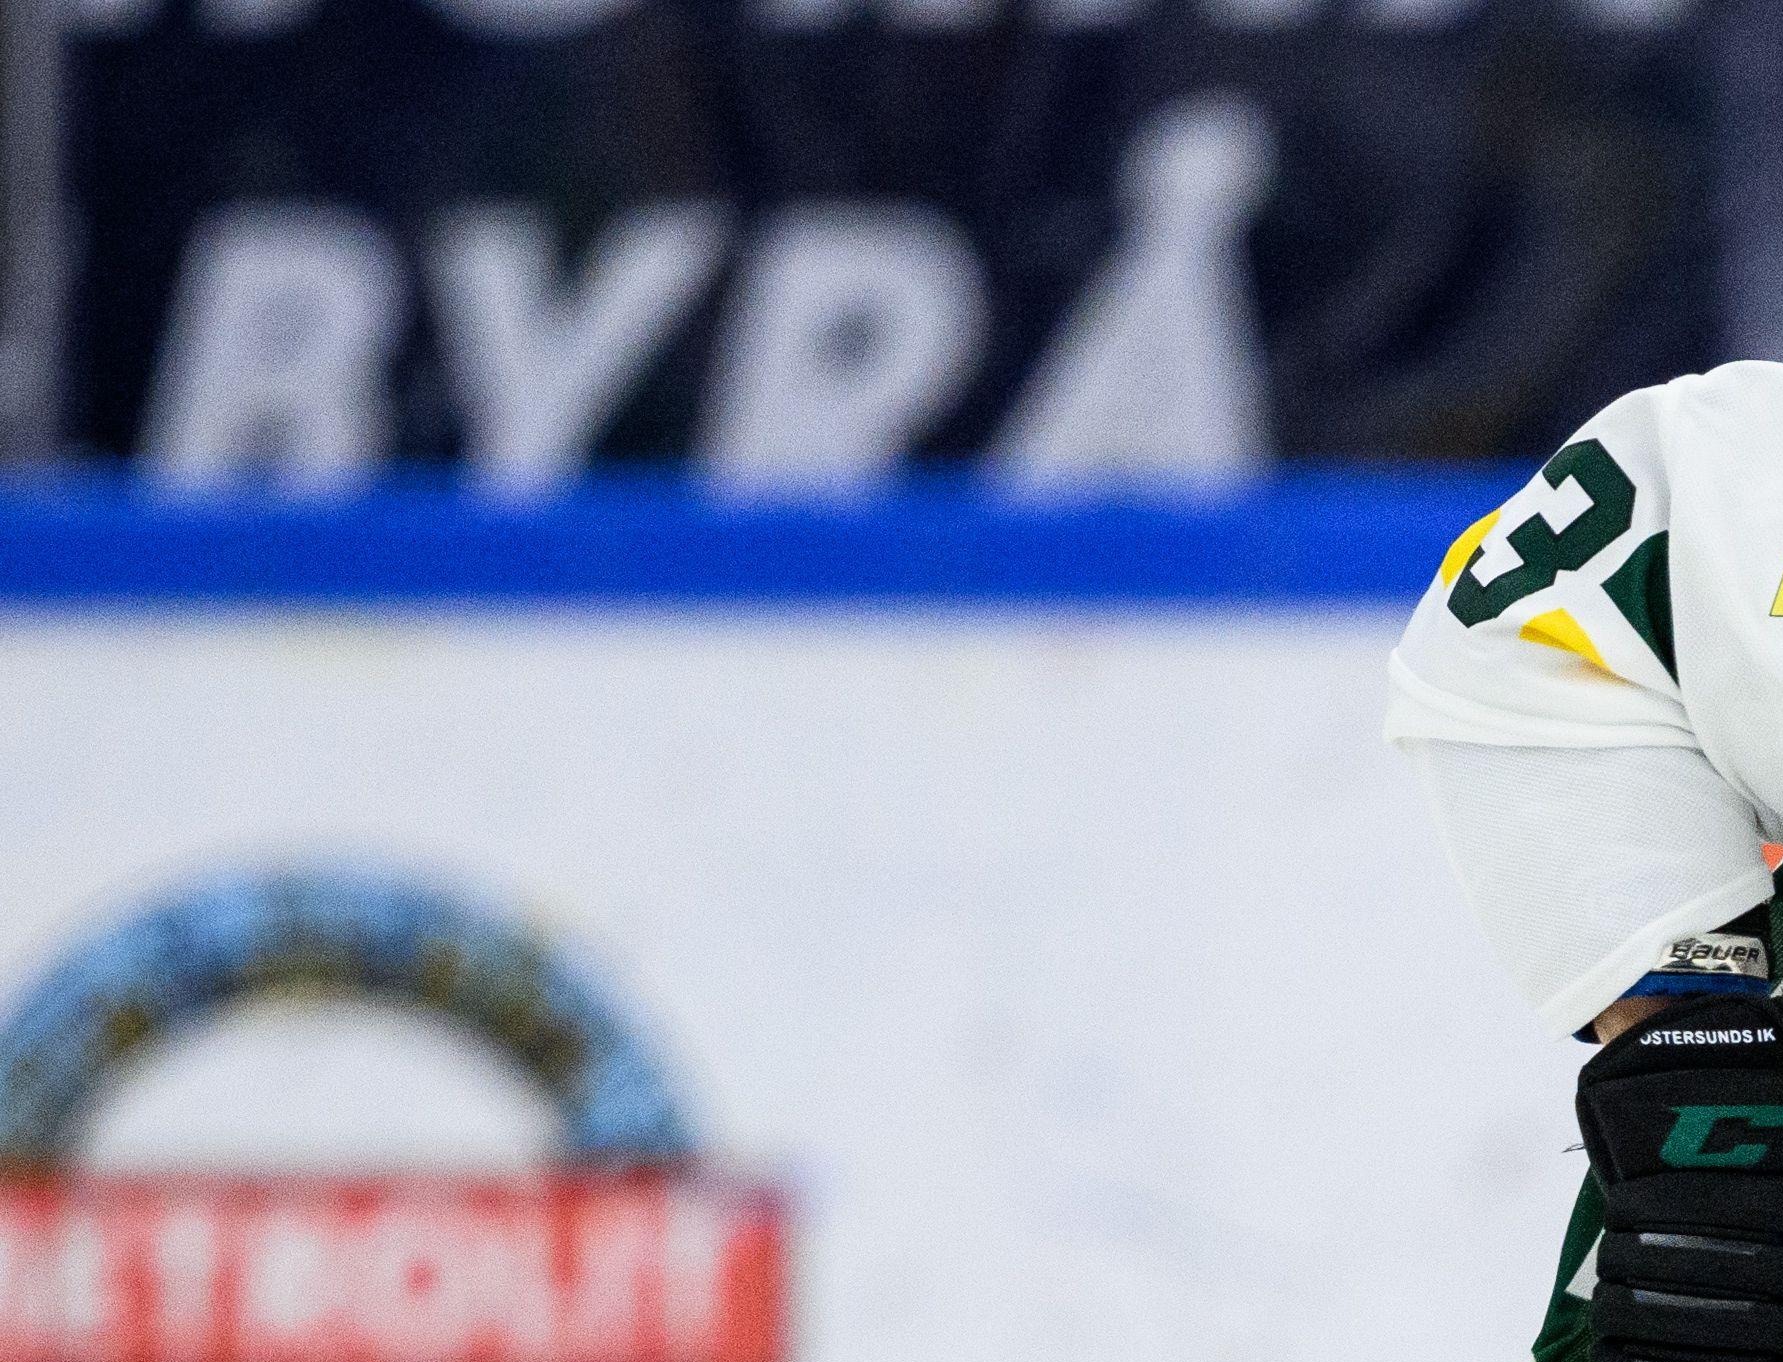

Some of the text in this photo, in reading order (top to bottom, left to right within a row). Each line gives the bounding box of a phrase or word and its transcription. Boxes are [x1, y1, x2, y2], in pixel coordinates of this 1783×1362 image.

[140, 90, 1280, 495] BYRÅ
[1447, 438, 1636, 629] 3
[1756, 1028, 1777, 1043] IK
